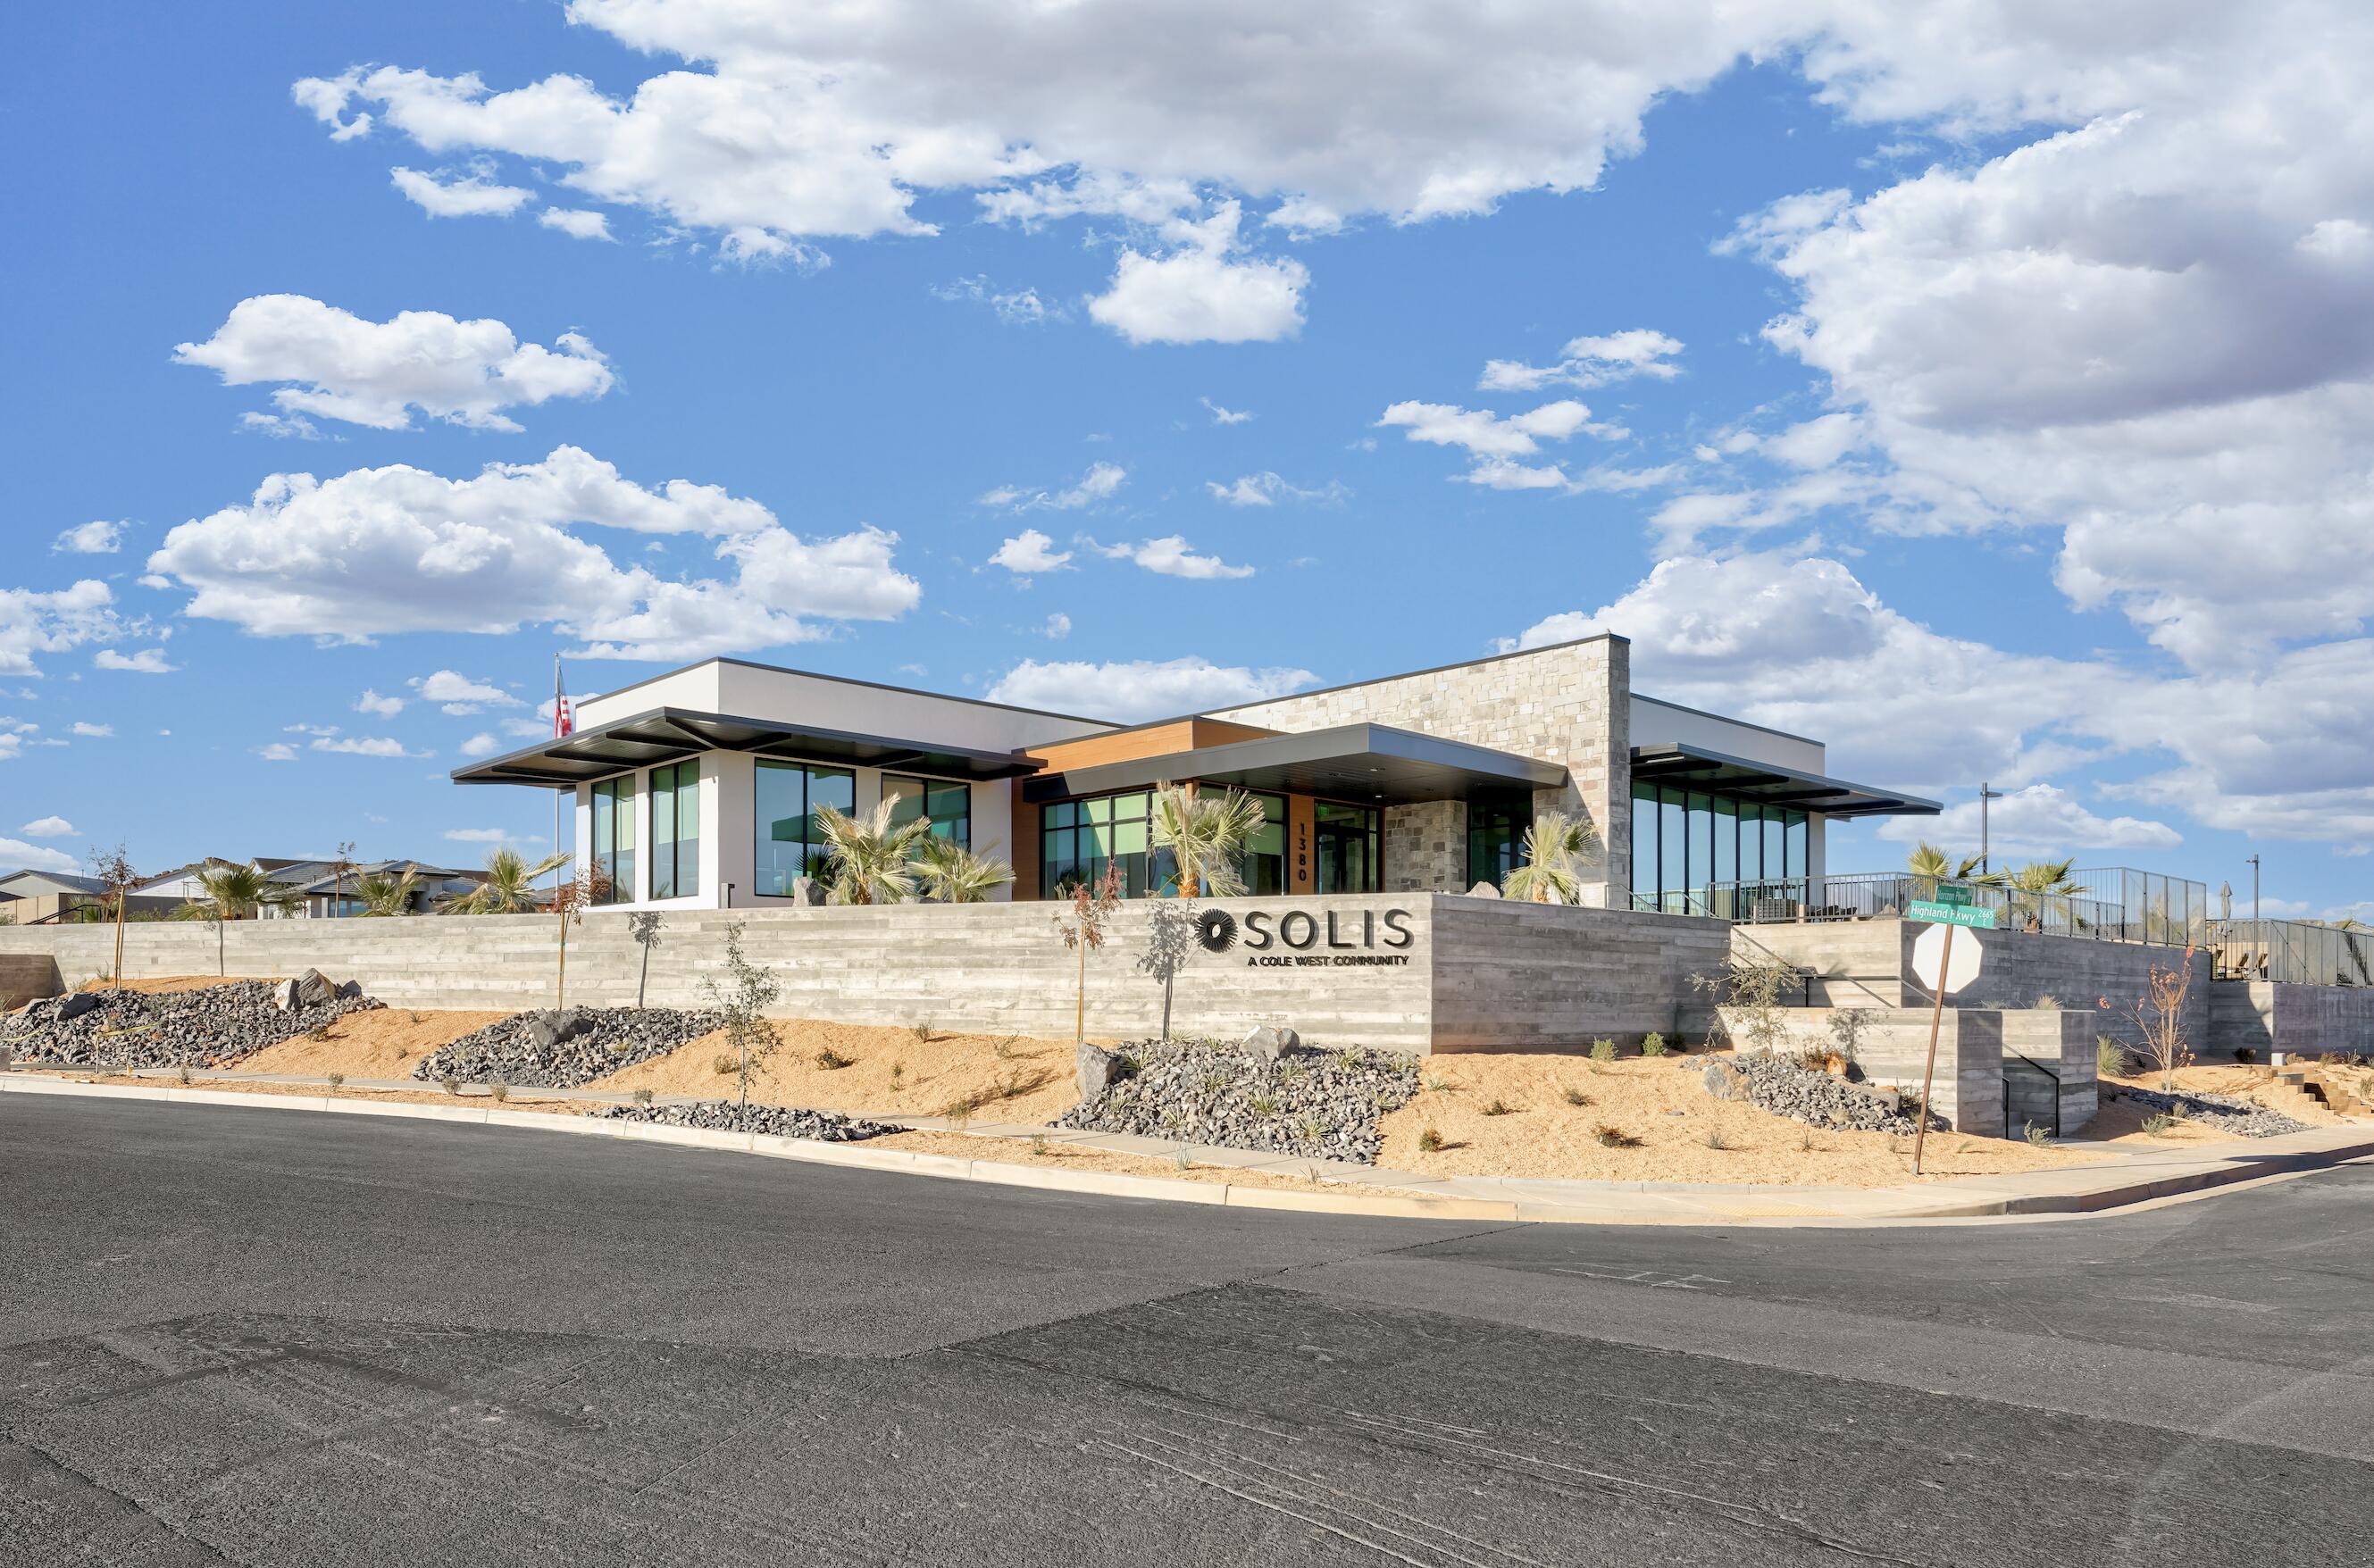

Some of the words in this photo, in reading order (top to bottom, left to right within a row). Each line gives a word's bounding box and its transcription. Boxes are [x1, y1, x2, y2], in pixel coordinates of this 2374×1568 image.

[1299, 822, 1307, 881] 1380
[1910, 905, 1948, 919] Highland
[1978, 909, 1994, 919] 2665
[1244, 908, 1414, 949] SOLIS
[1248, 956, 1258, 967] A
[1259, 956, 1292, 967] COLE
[1295, 955, 1330, 967] WEST
[1333, 955, 1409, 966] COMMUNITY
